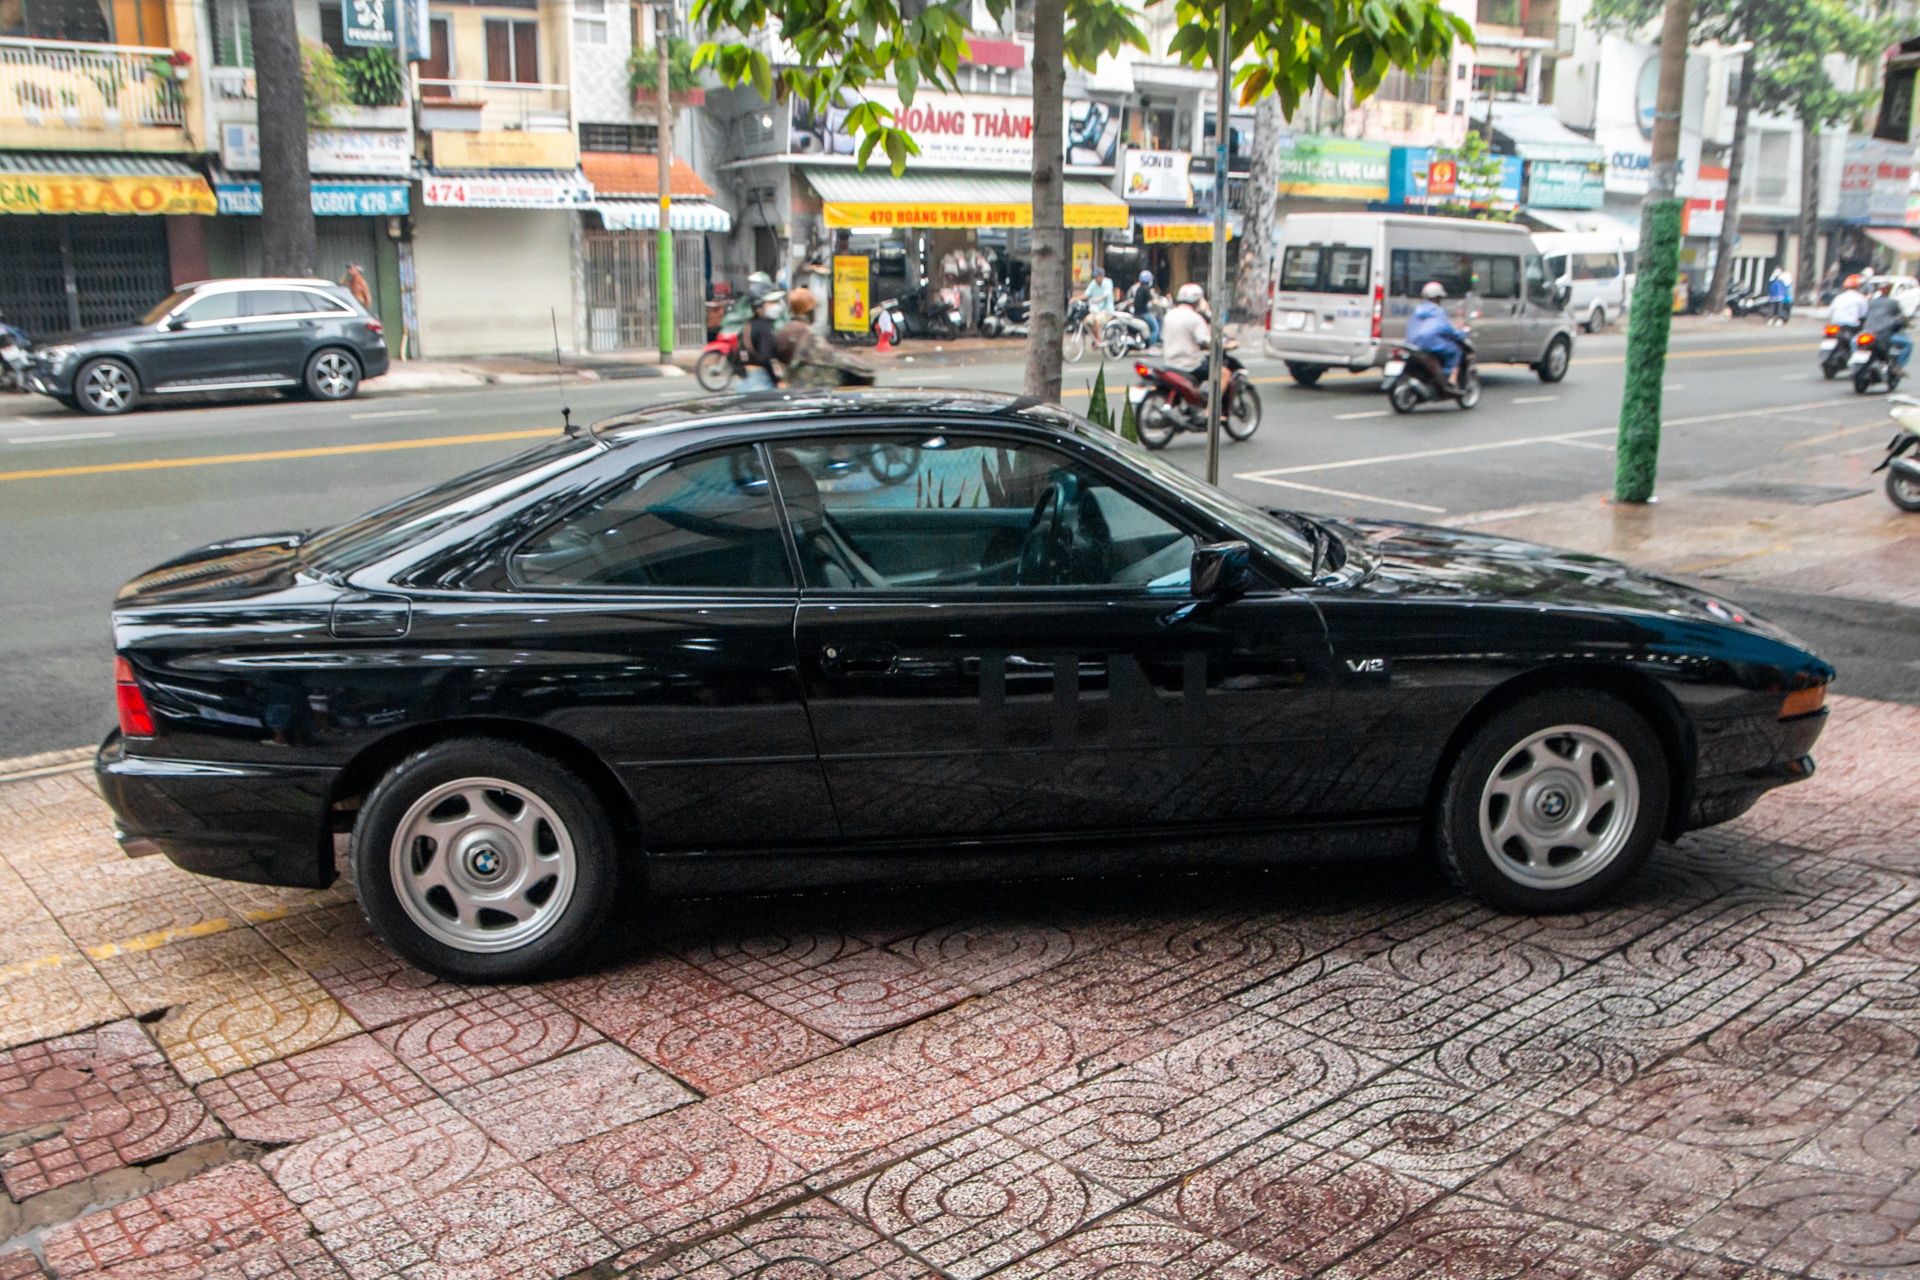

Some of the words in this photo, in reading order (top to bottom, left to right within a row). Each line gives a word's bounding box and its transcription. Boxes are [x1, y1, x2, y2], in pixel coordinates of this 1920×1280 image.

[894, 103, 965, 135] HOÀNG
[427, 185, 466, 203] 474
[869, 210, 892, 223] 470
[897, 206, 937, 223] HOÀNG
[942, 206, 982, 223] THÀNH
[986, 210, 1016, 224] AUTO
[1346, 659, 1384, 672] V12
